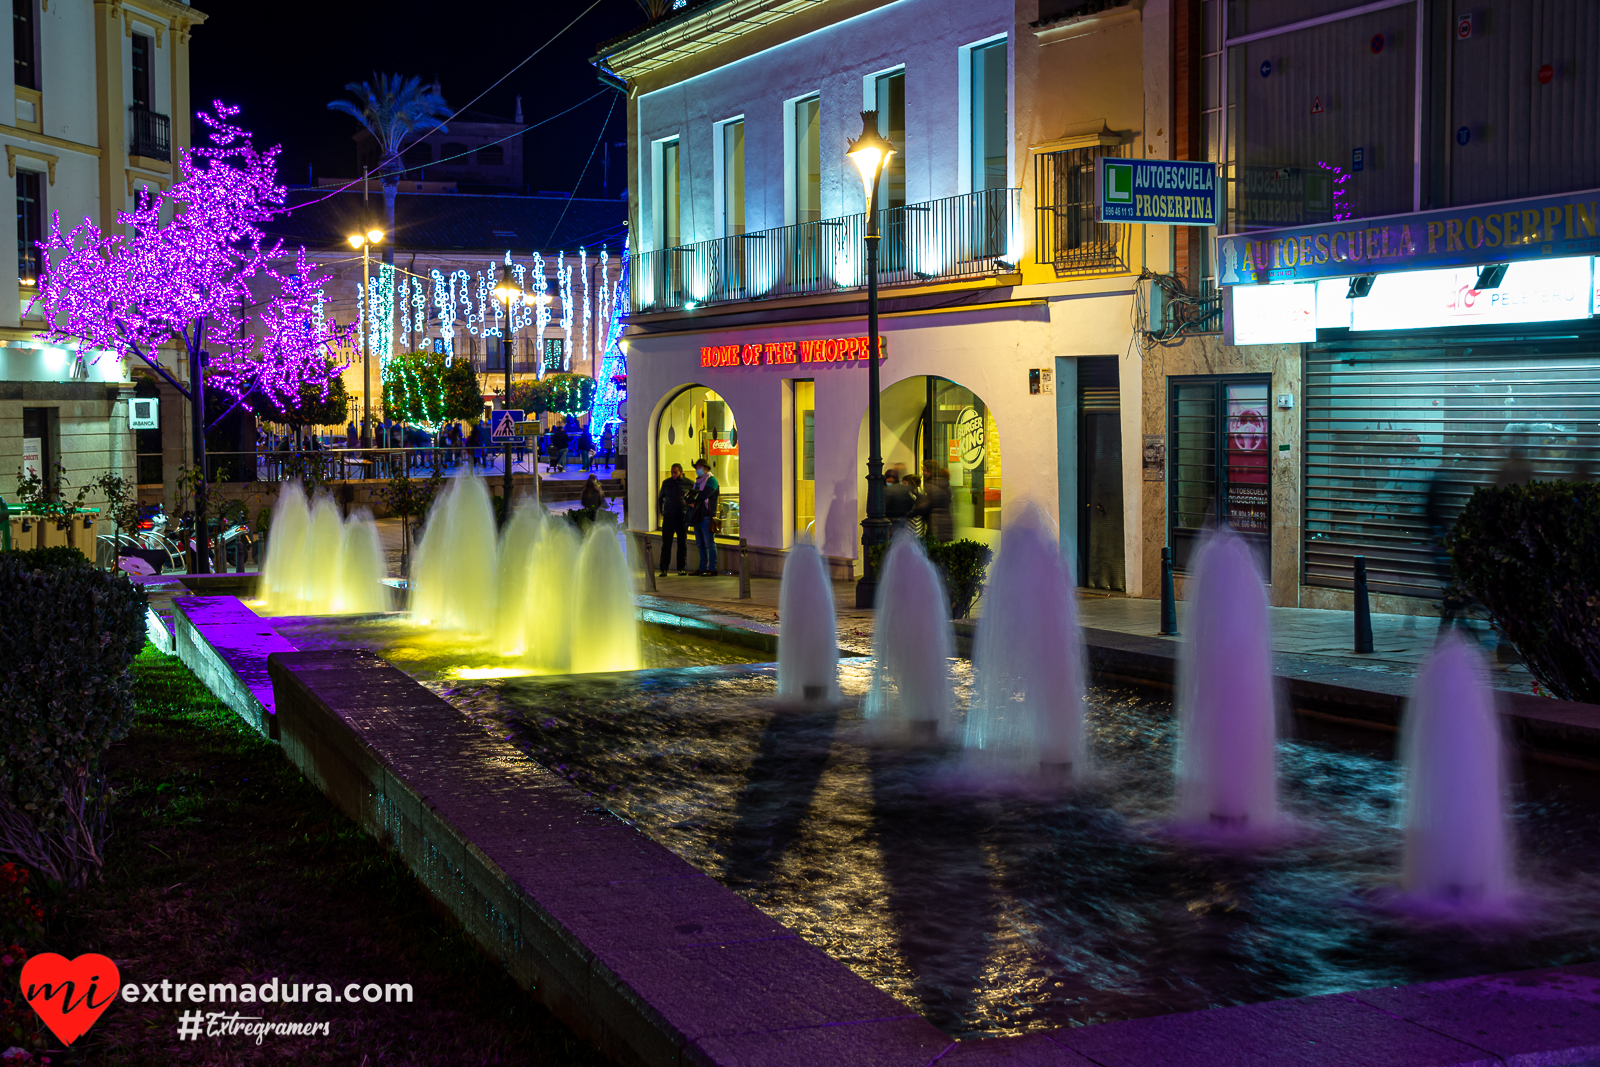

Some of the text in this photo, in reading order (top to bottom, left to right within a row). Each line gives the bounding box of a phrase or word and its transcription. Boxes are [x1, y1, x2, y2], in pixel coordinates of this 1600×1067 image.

[1135, 165, 1213, 190] AUTOESCUELA
[1135, 194, 1213, 219] PROSERPINA
[1241, 201, 1600, 272] AUTOESCUELA PROSERPIN
[1491, 290, 1575, 306] PELEERO
[700, 345, 740, 368] HOME
[742, 344, 763, 366] OF
[765, 342, 797, 365] THE
[957, 416, 983, 440] BURGER
[959, 428, 984, 454] KING
